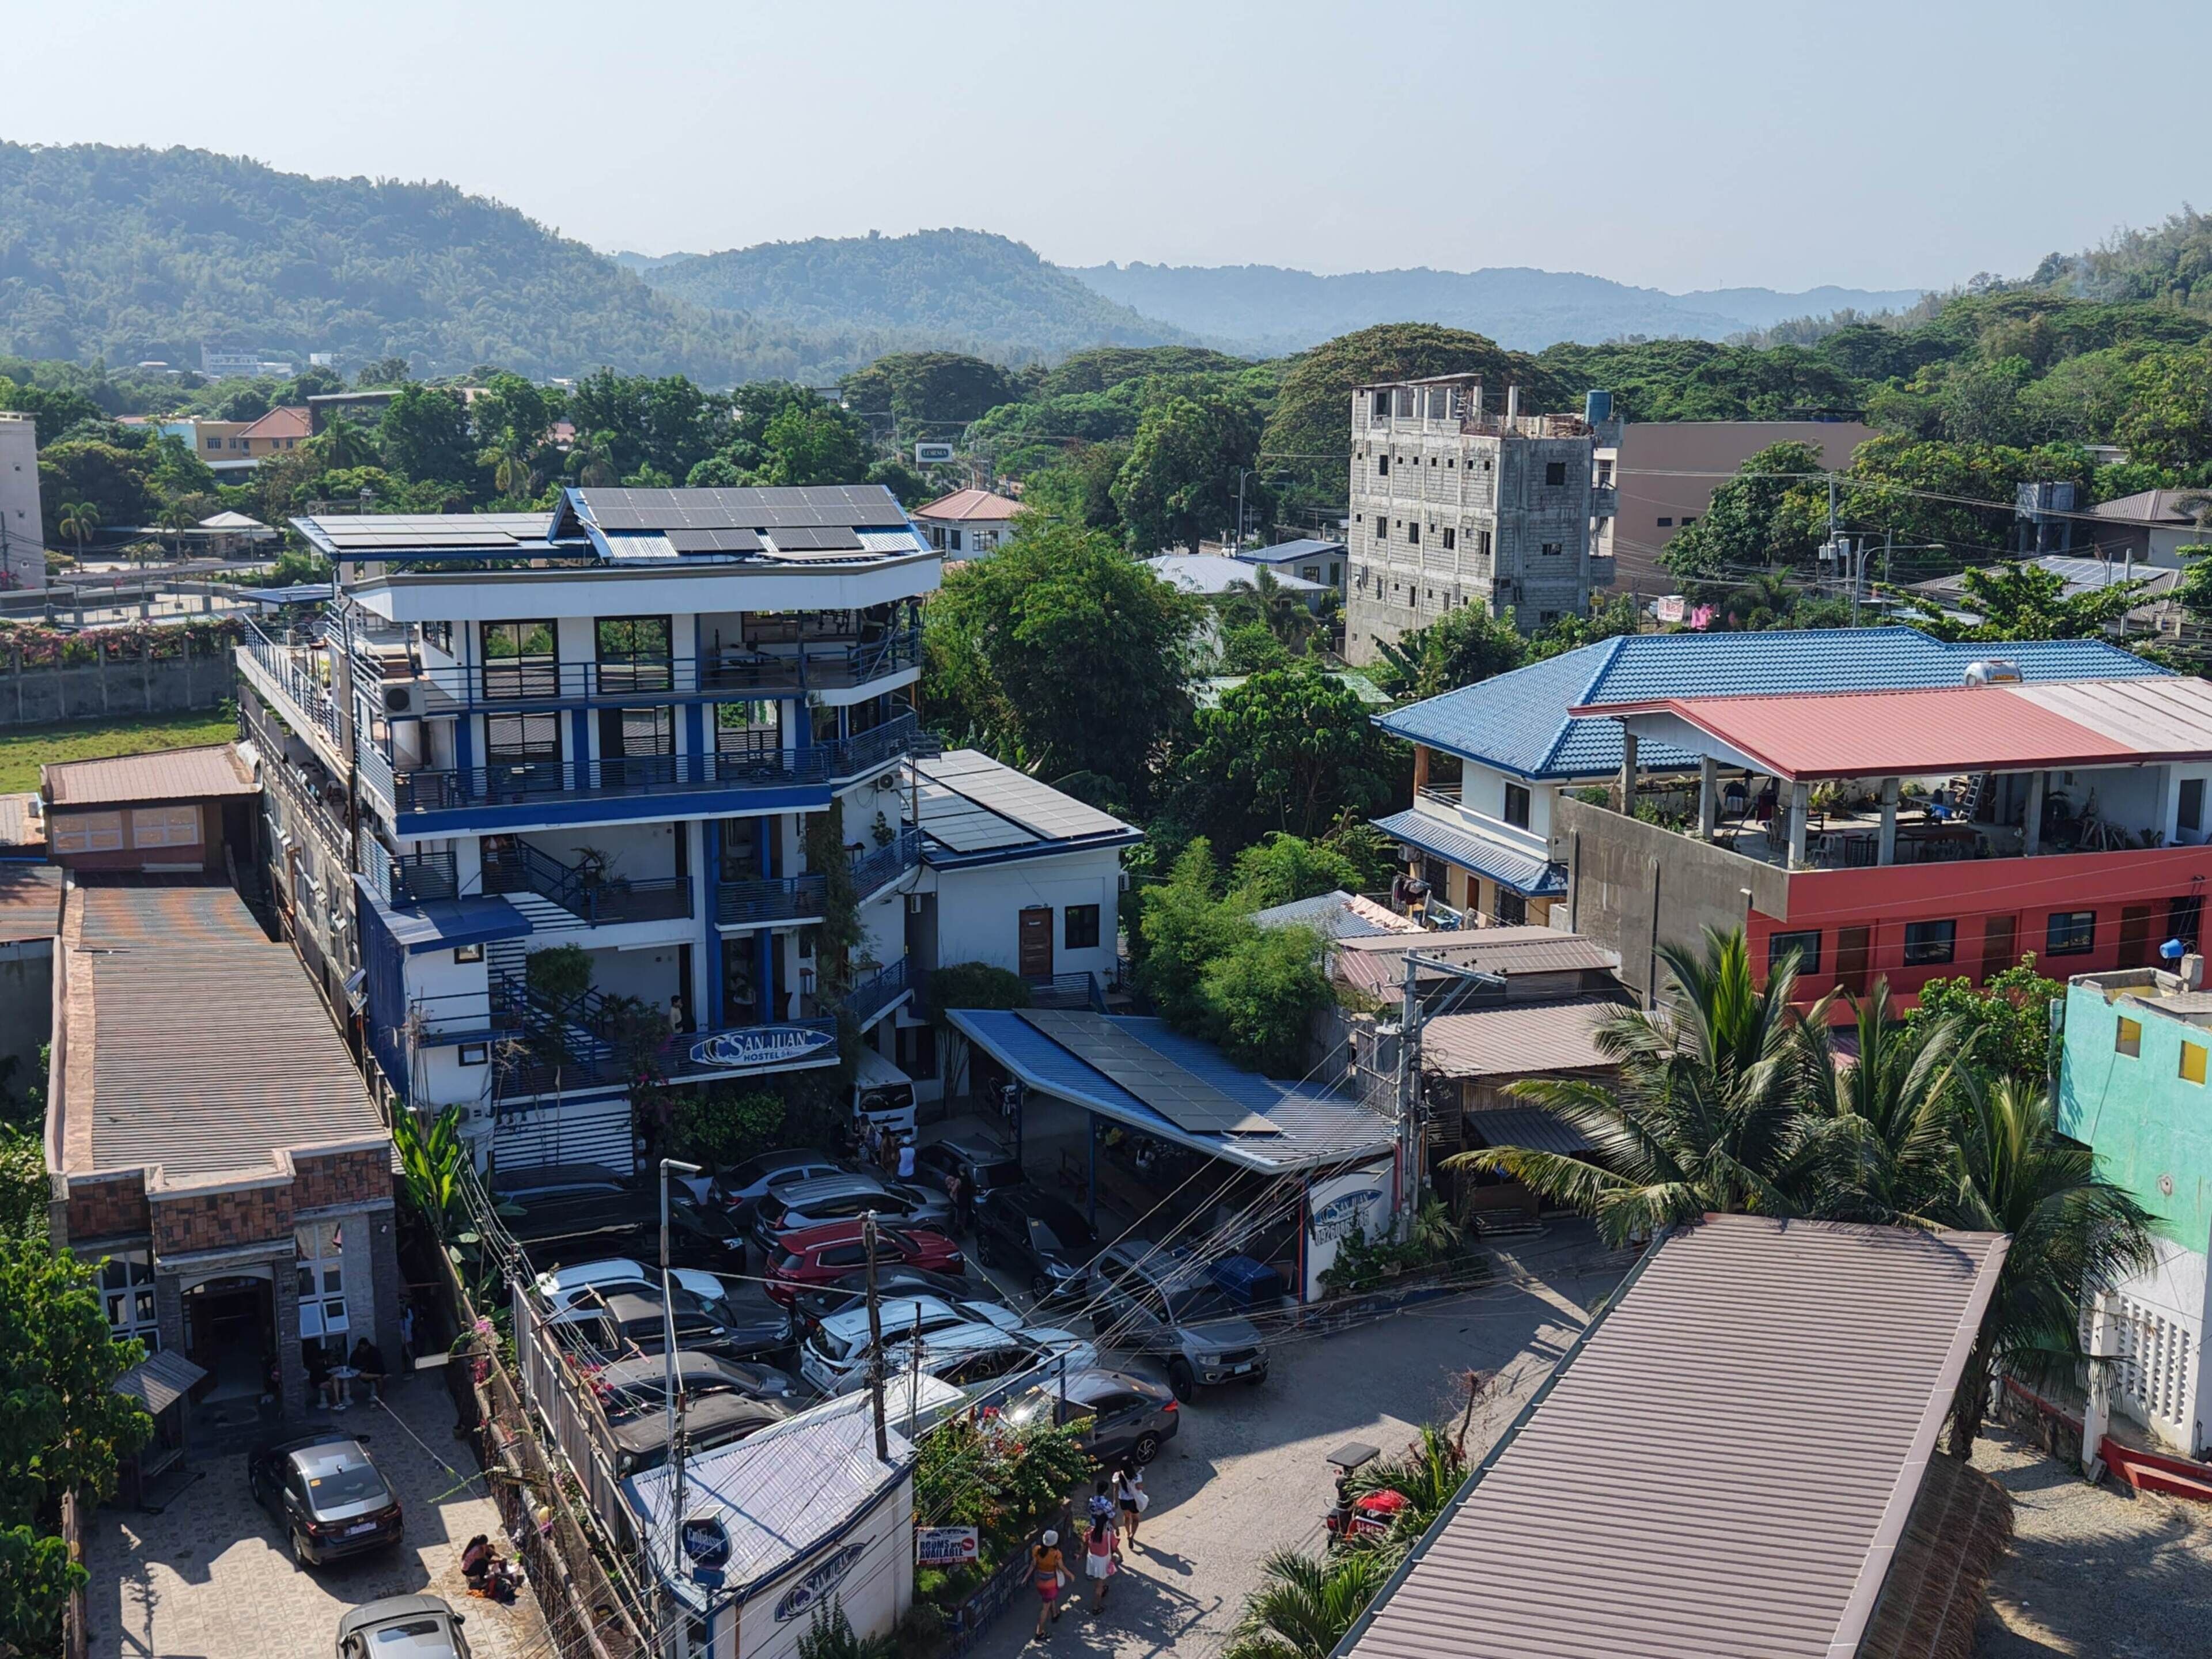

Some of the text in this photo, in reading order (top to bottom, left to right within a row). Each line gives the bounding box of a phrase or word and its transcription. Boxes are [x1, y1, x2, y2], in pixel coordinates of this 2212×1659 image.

[729, 1032, 806, 1058] SAN JUAN
[744, 1052, 779, 1062] HOSTEL
[920, 1540, 950, 1550] ROOMS
[920, 1547, 964, 1559] AVAILABLE
[803, 1572, 828, 1603] SAN
[828, 1552, 850, 1580] JUAN
